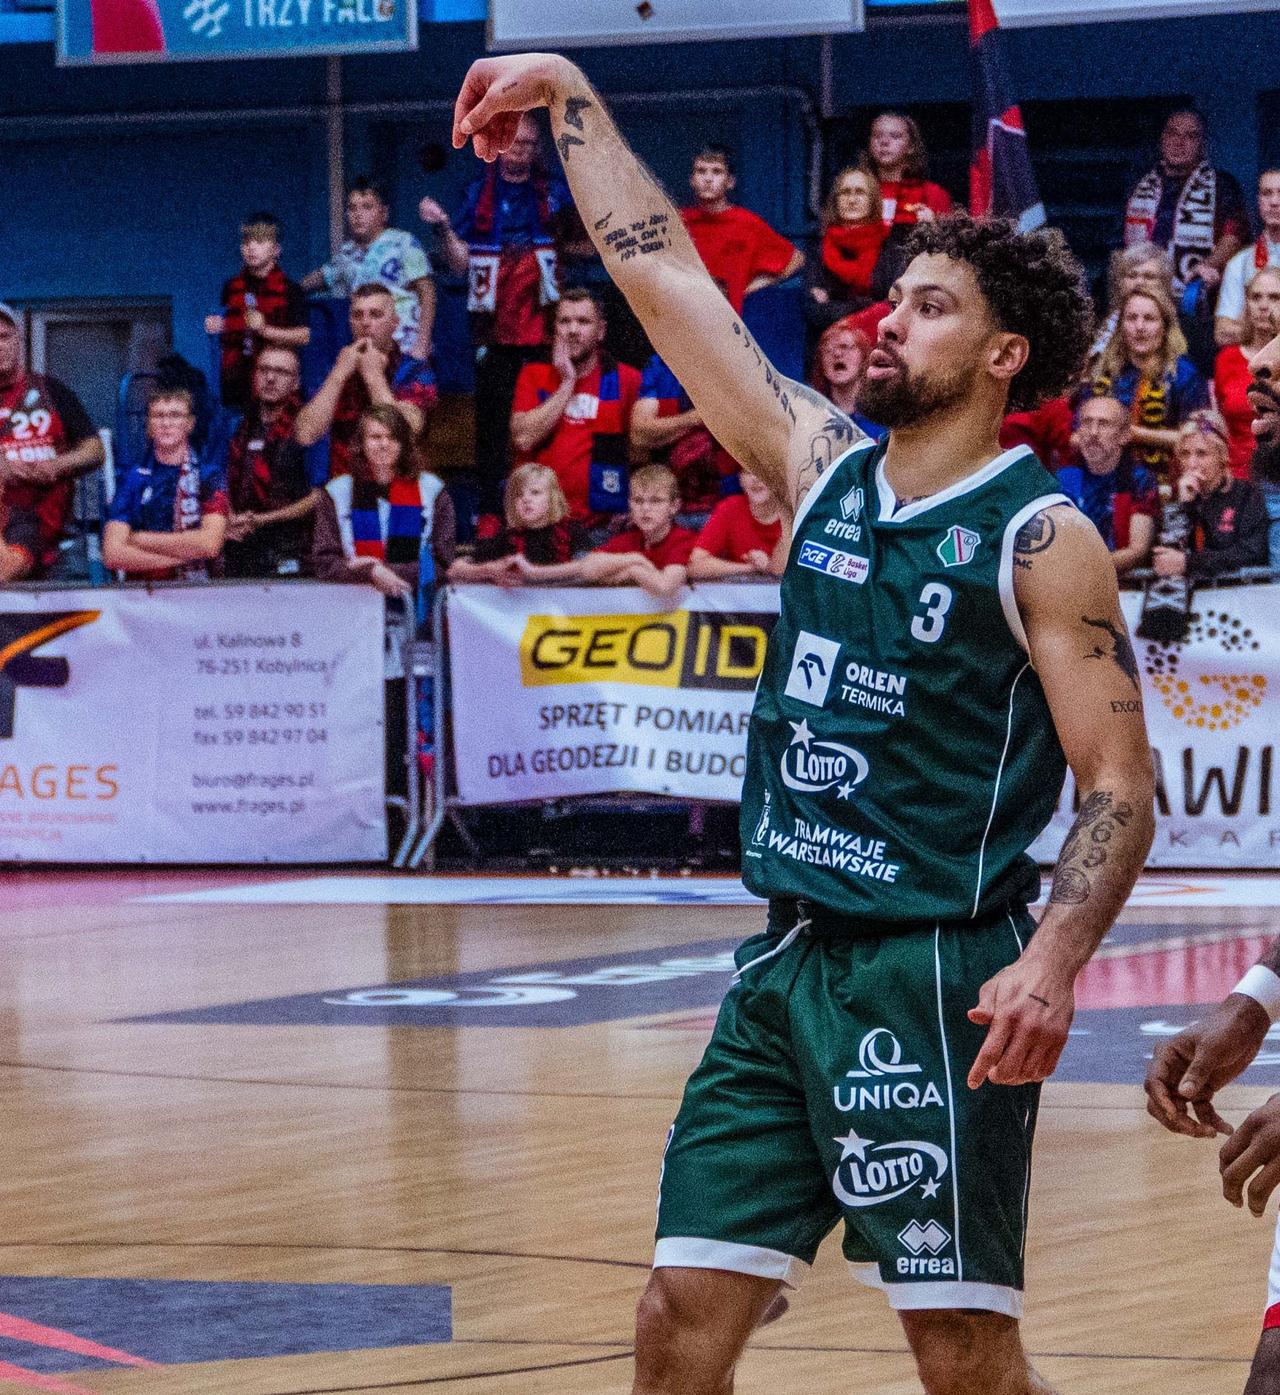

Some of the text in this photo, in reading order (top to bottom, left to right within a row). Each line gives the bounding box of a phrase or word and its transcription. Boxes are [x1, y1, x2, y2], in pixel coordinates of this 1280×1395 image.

[10, 408, 51, 440] 29
[801, 547, 828, 565] PGE
[843, 567, 858, 578] Liga
[910, 582, 953, 643] 3
[291, 630, 303, 648] 8
[531, 623, 768, 679] GEOID
[845, 662, 907, 695] ORLEN
[224, 703, 245, 720] 59
[249, 703, 280, 719] 842
[284, 702, 305, 719] 90
[308, 702, 326, 719] 51
[841, 685, 905, 717] TERMIKA
[539, 702, 627, 733] SPRZĘT
[223, 729, 244, 745] 59
[247, 729, 279, 745] 842
[282, 728, 303, 743] 97
[306, 728, 328, 744] 04
[488, 752, 526, 779] DLA
[530, 744, 639, 775] GEODEZJI
[648, 749, 656, 770] I
[796, 749, 847, 782] LOTTO
[794, 818, 886, 860] TRAMWAJE
[768, 829, 899, 883] WARSZAWSKIE
[833, 1081, 944, 1112] UNIQA
[849, 1152, 923, 1193] LOTTO
